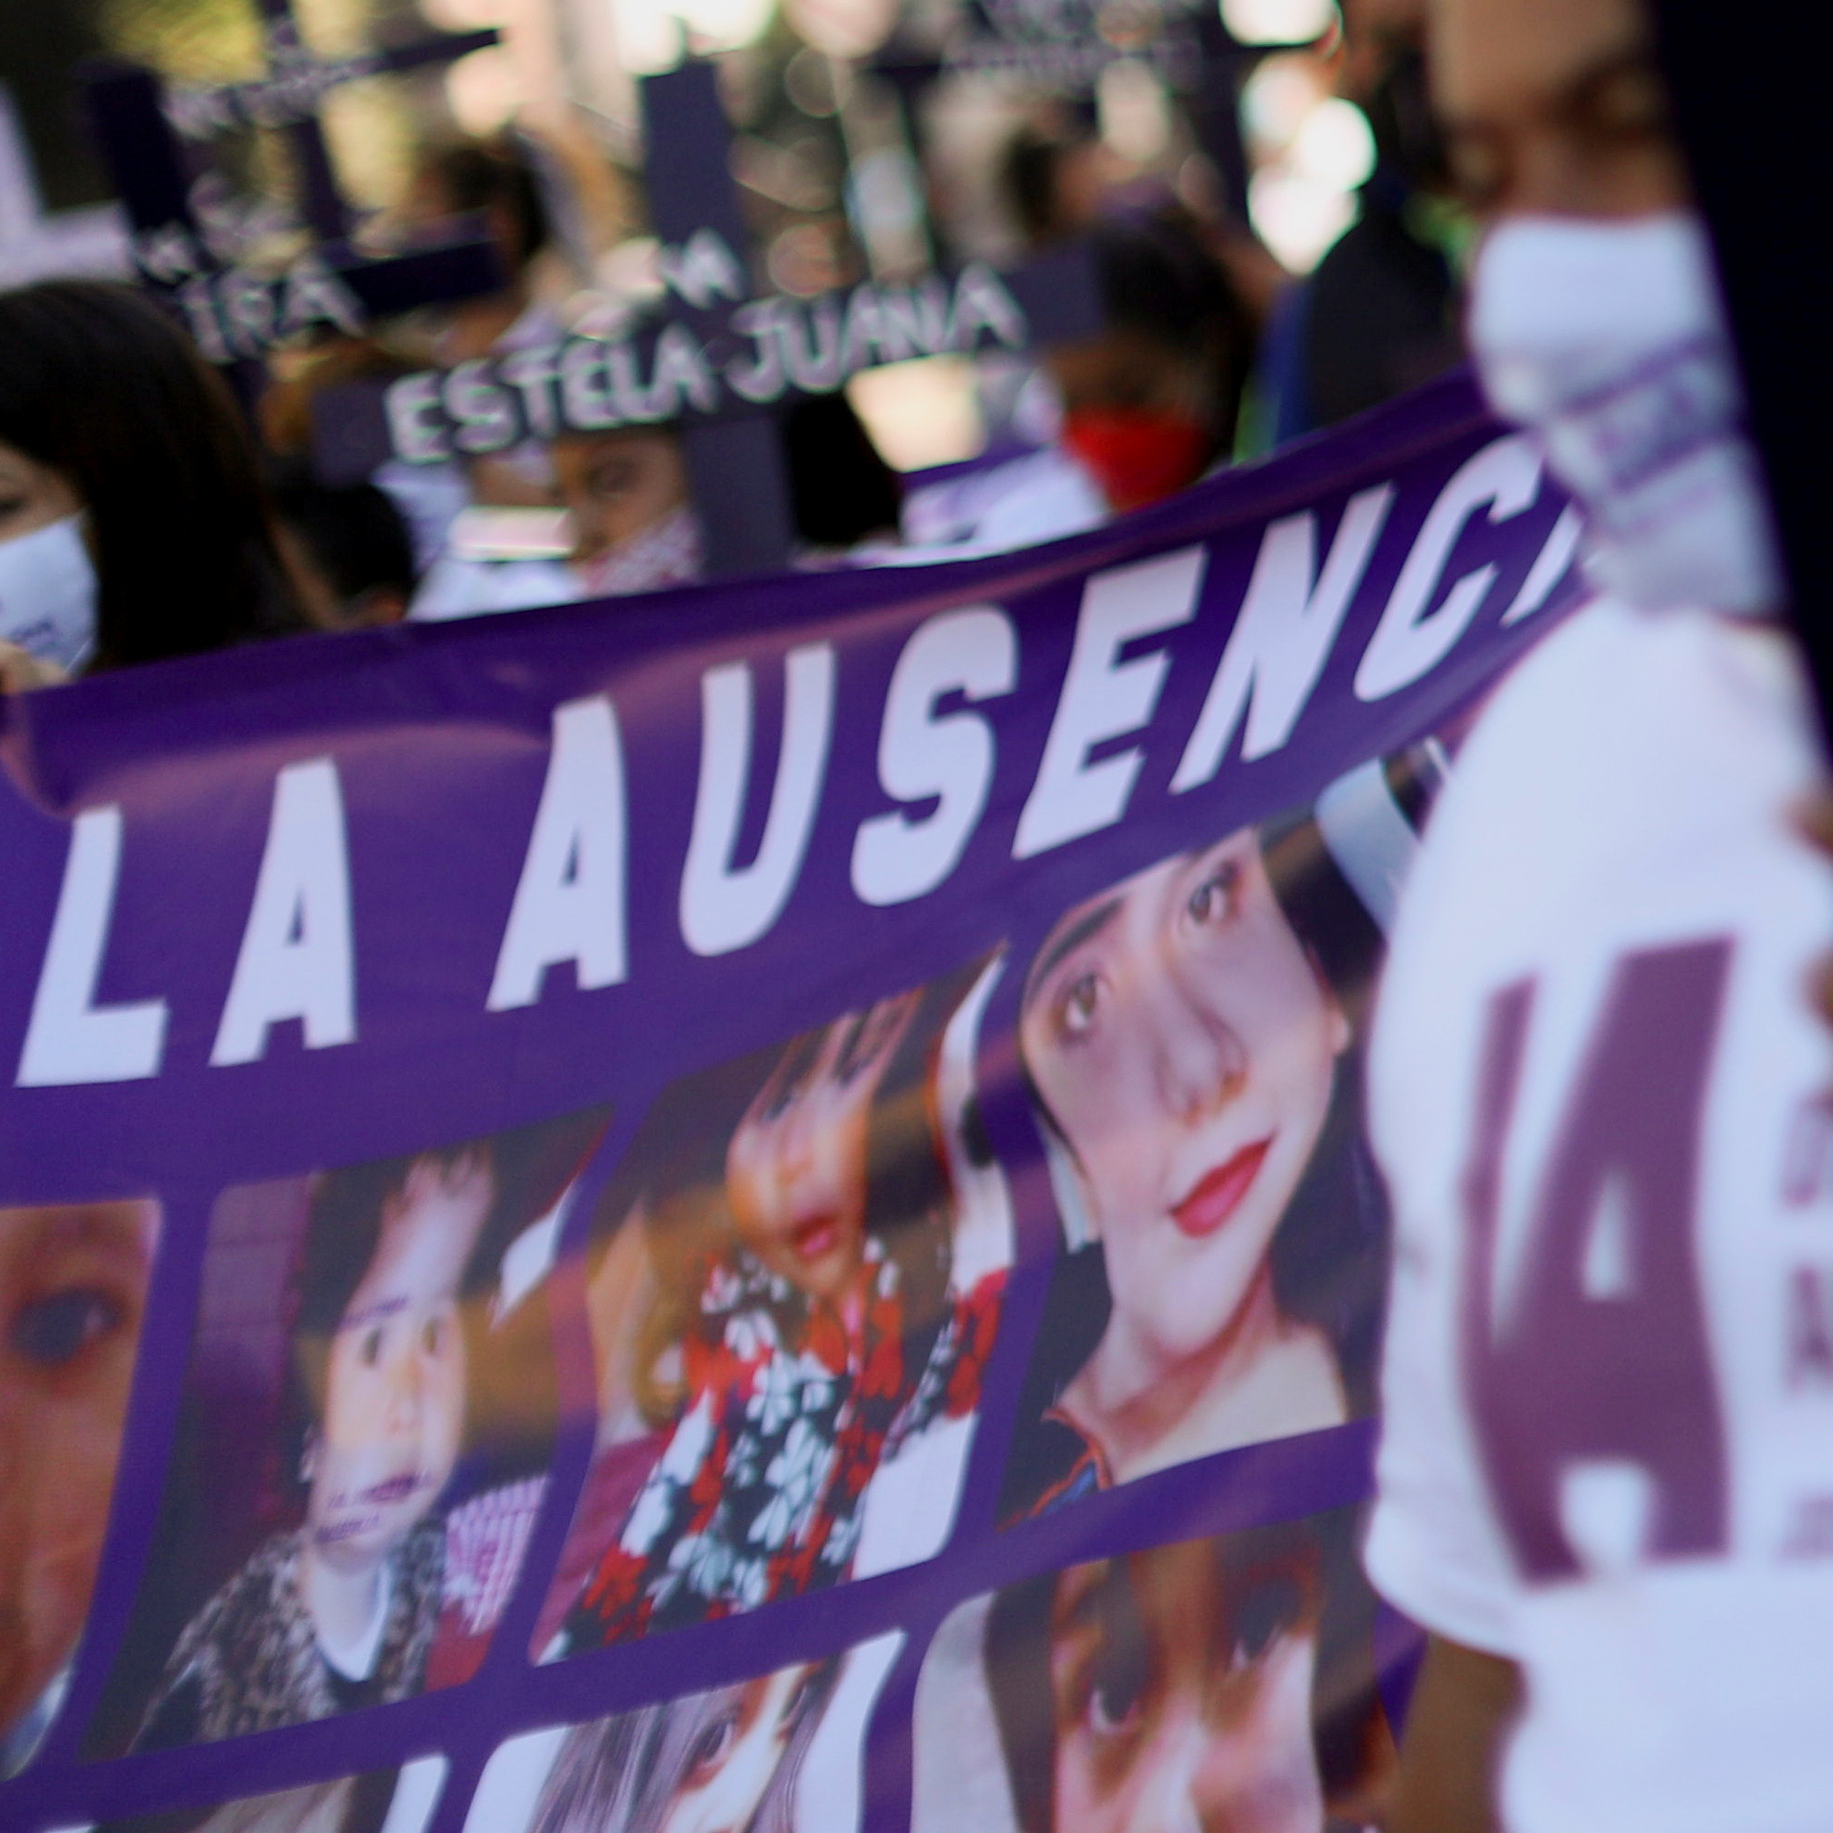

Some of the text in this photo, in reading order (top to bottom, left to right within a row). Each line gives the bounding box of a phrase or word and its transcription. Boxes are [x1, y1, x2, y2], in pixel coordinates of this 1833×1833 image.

[384, 264, 1026, 464] ESTELA JUANA
[13, 432, 1590, 1090] LA AUSENCI
